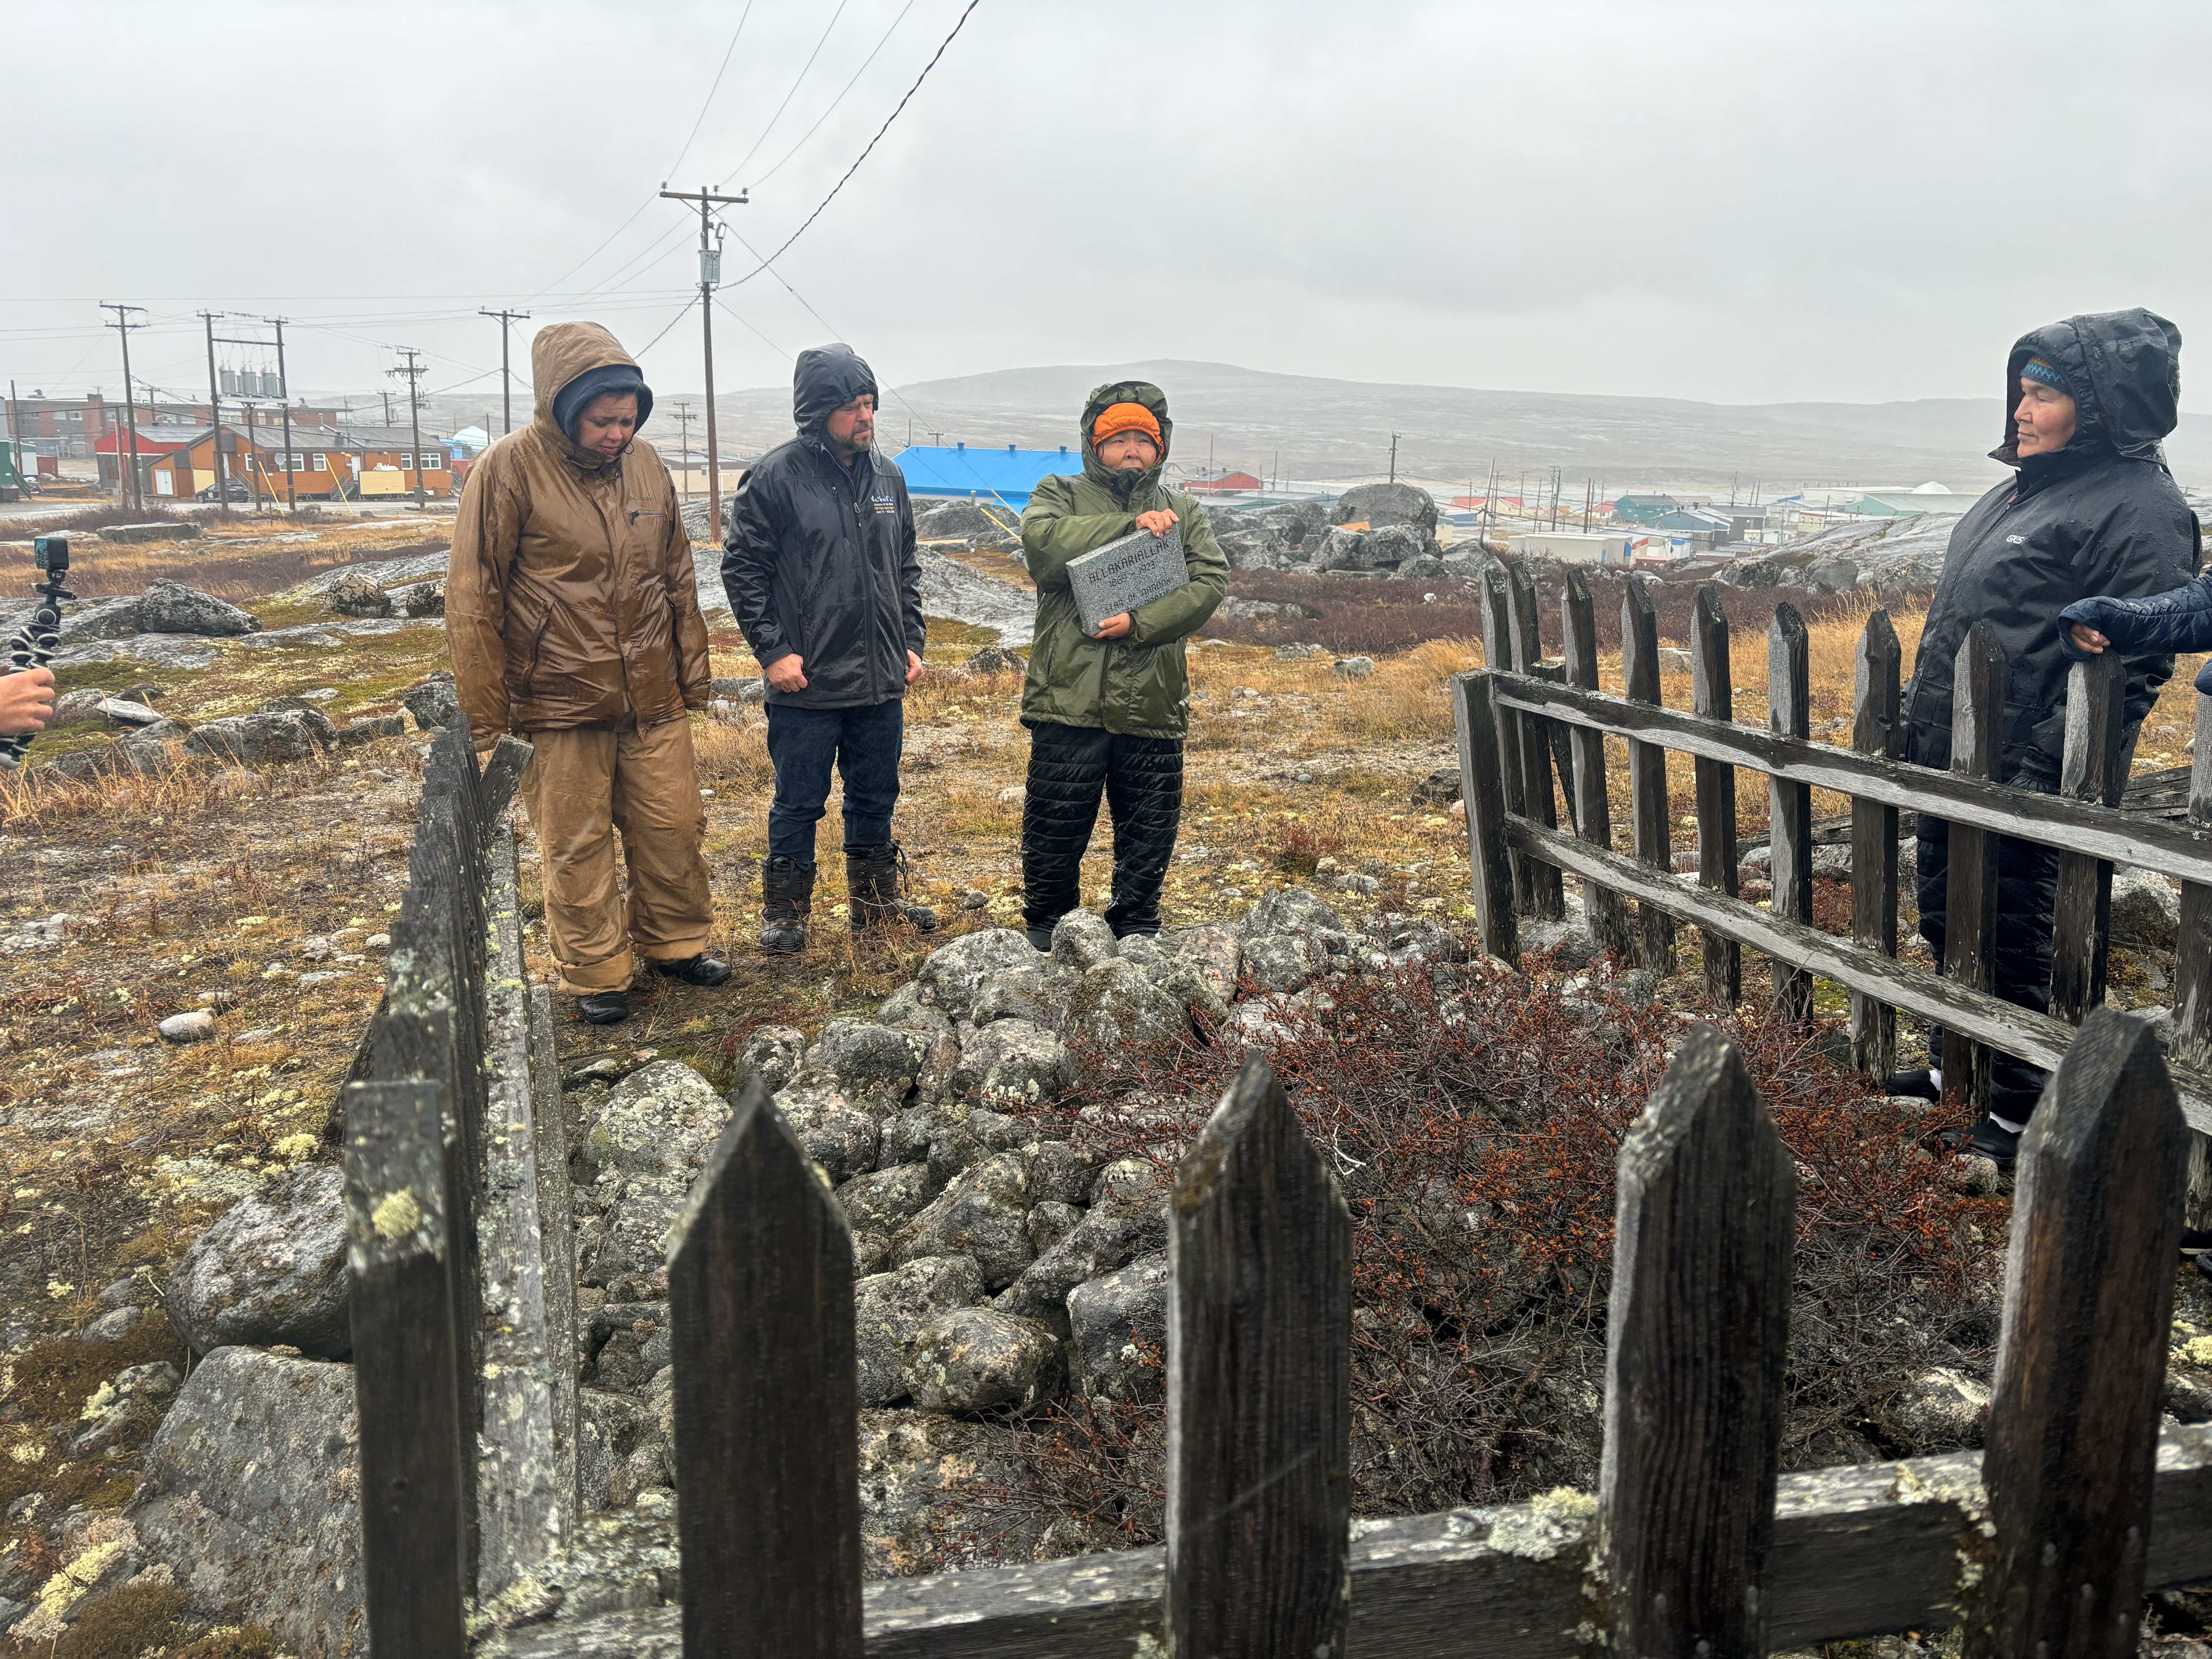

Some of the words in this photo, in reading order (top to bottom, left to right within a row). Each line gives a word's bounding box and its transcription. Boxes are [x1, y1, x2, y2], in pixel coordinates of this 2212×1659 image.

[1089, 538, 1170, 584] ALLAKARIALLAK
[1109, 574, 1127, 588] 1869
[1139, 560, 1156, 574] 1923
[1105, 599, 1124, 614] STAR
[1128, 593, 1137, 602] OF
[1142, 577, 1172, 596] NANOOK
